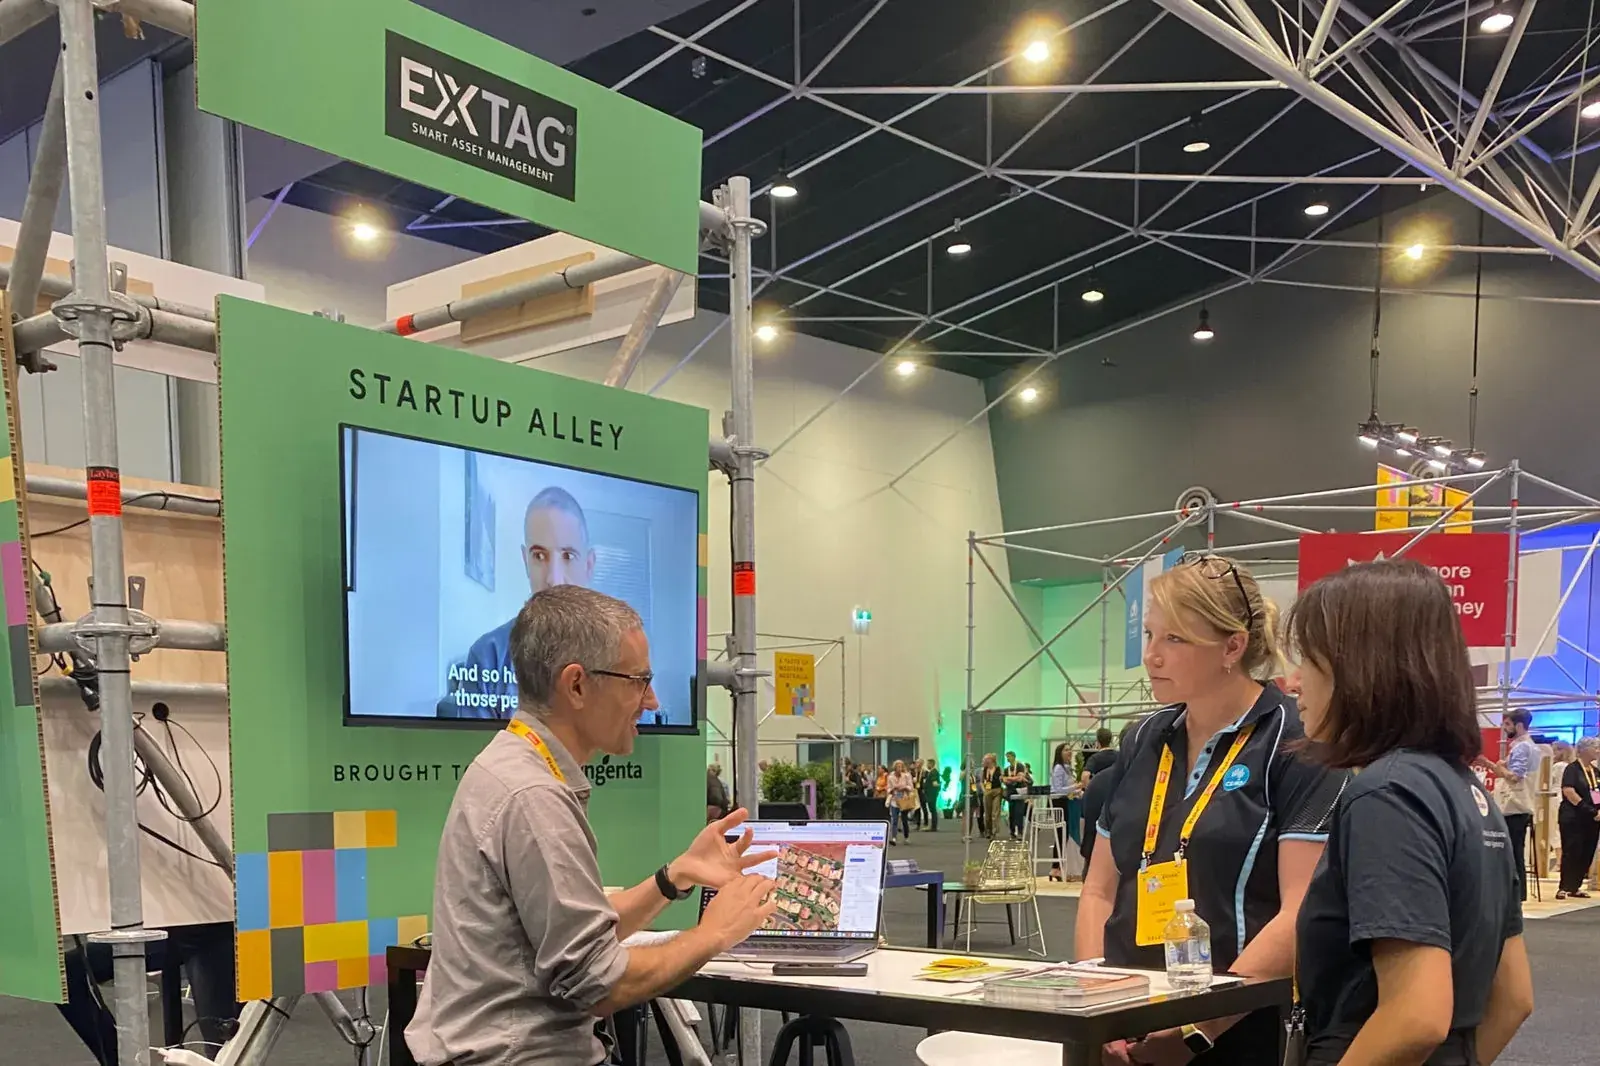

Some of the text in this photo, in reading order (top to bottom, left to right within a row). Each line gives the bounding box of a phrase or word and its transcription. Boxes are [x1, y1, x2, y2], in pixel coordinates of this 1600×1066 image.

[411, 122, 554, 183] SMART ASSET MANAGEMENT
[349, 368, 624, 451] STARTUP ALLEY
[448, 663, 478, 682] And
[482, 669, 500, 683] so
[455, 687, 498, 708] those
[333, 764, 470, 782] BROUGHT T
[581, 761, 643, 786] ngenta
